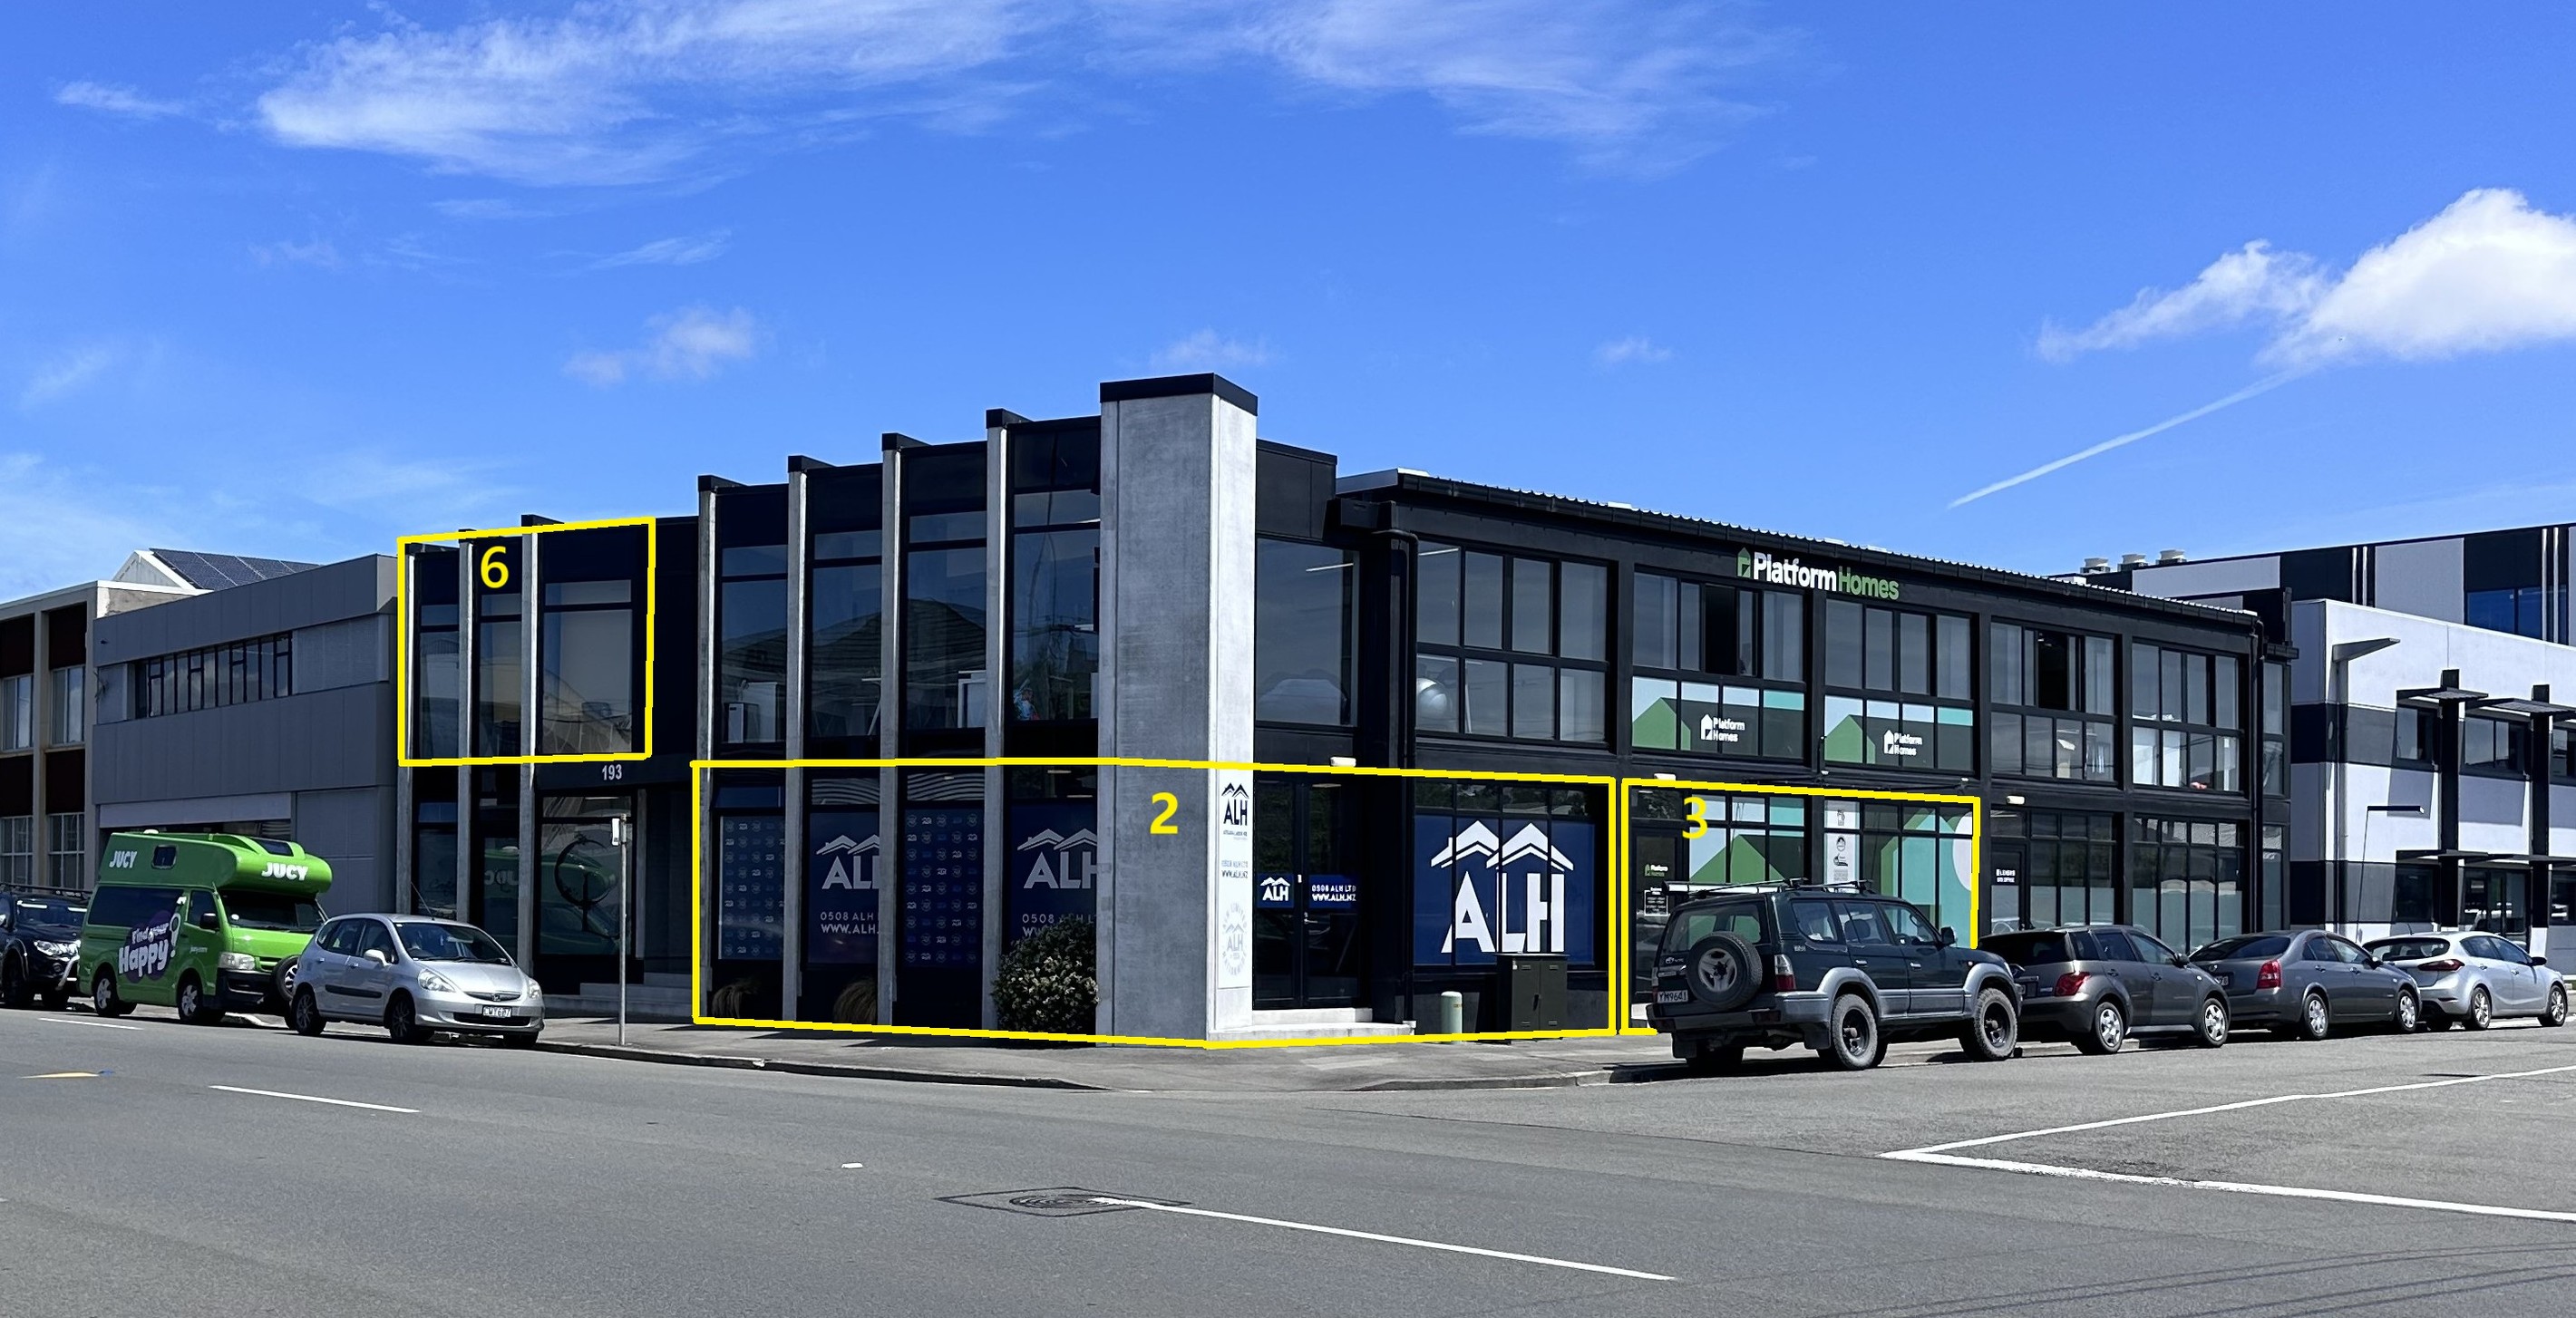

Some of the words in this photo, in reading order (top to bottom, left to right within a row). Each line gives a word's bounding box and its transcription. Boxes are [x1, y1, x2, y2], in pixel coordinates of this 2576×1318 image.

[1754, 551, 1837, 592] Platform
[1838, 566, 1900, 600] Homes
[1713, 717, 1745, 731] Platform
[1713, 730, 1738, 742] Homes
[601, 763, 623, 780] 193
[1223, 799, 1249, 826] ALH
[109, 850, 137, 868] JUCY
[261, 861, 309, 881] JUCY
[1262, 886, 1289, 901] ALH
[820, 911, 849, 921] 0508
[852, 912, 874, 921] ALH
[1022, 914, 1055, 924] 0508
[1441, 870, 1565, 954] ALH
